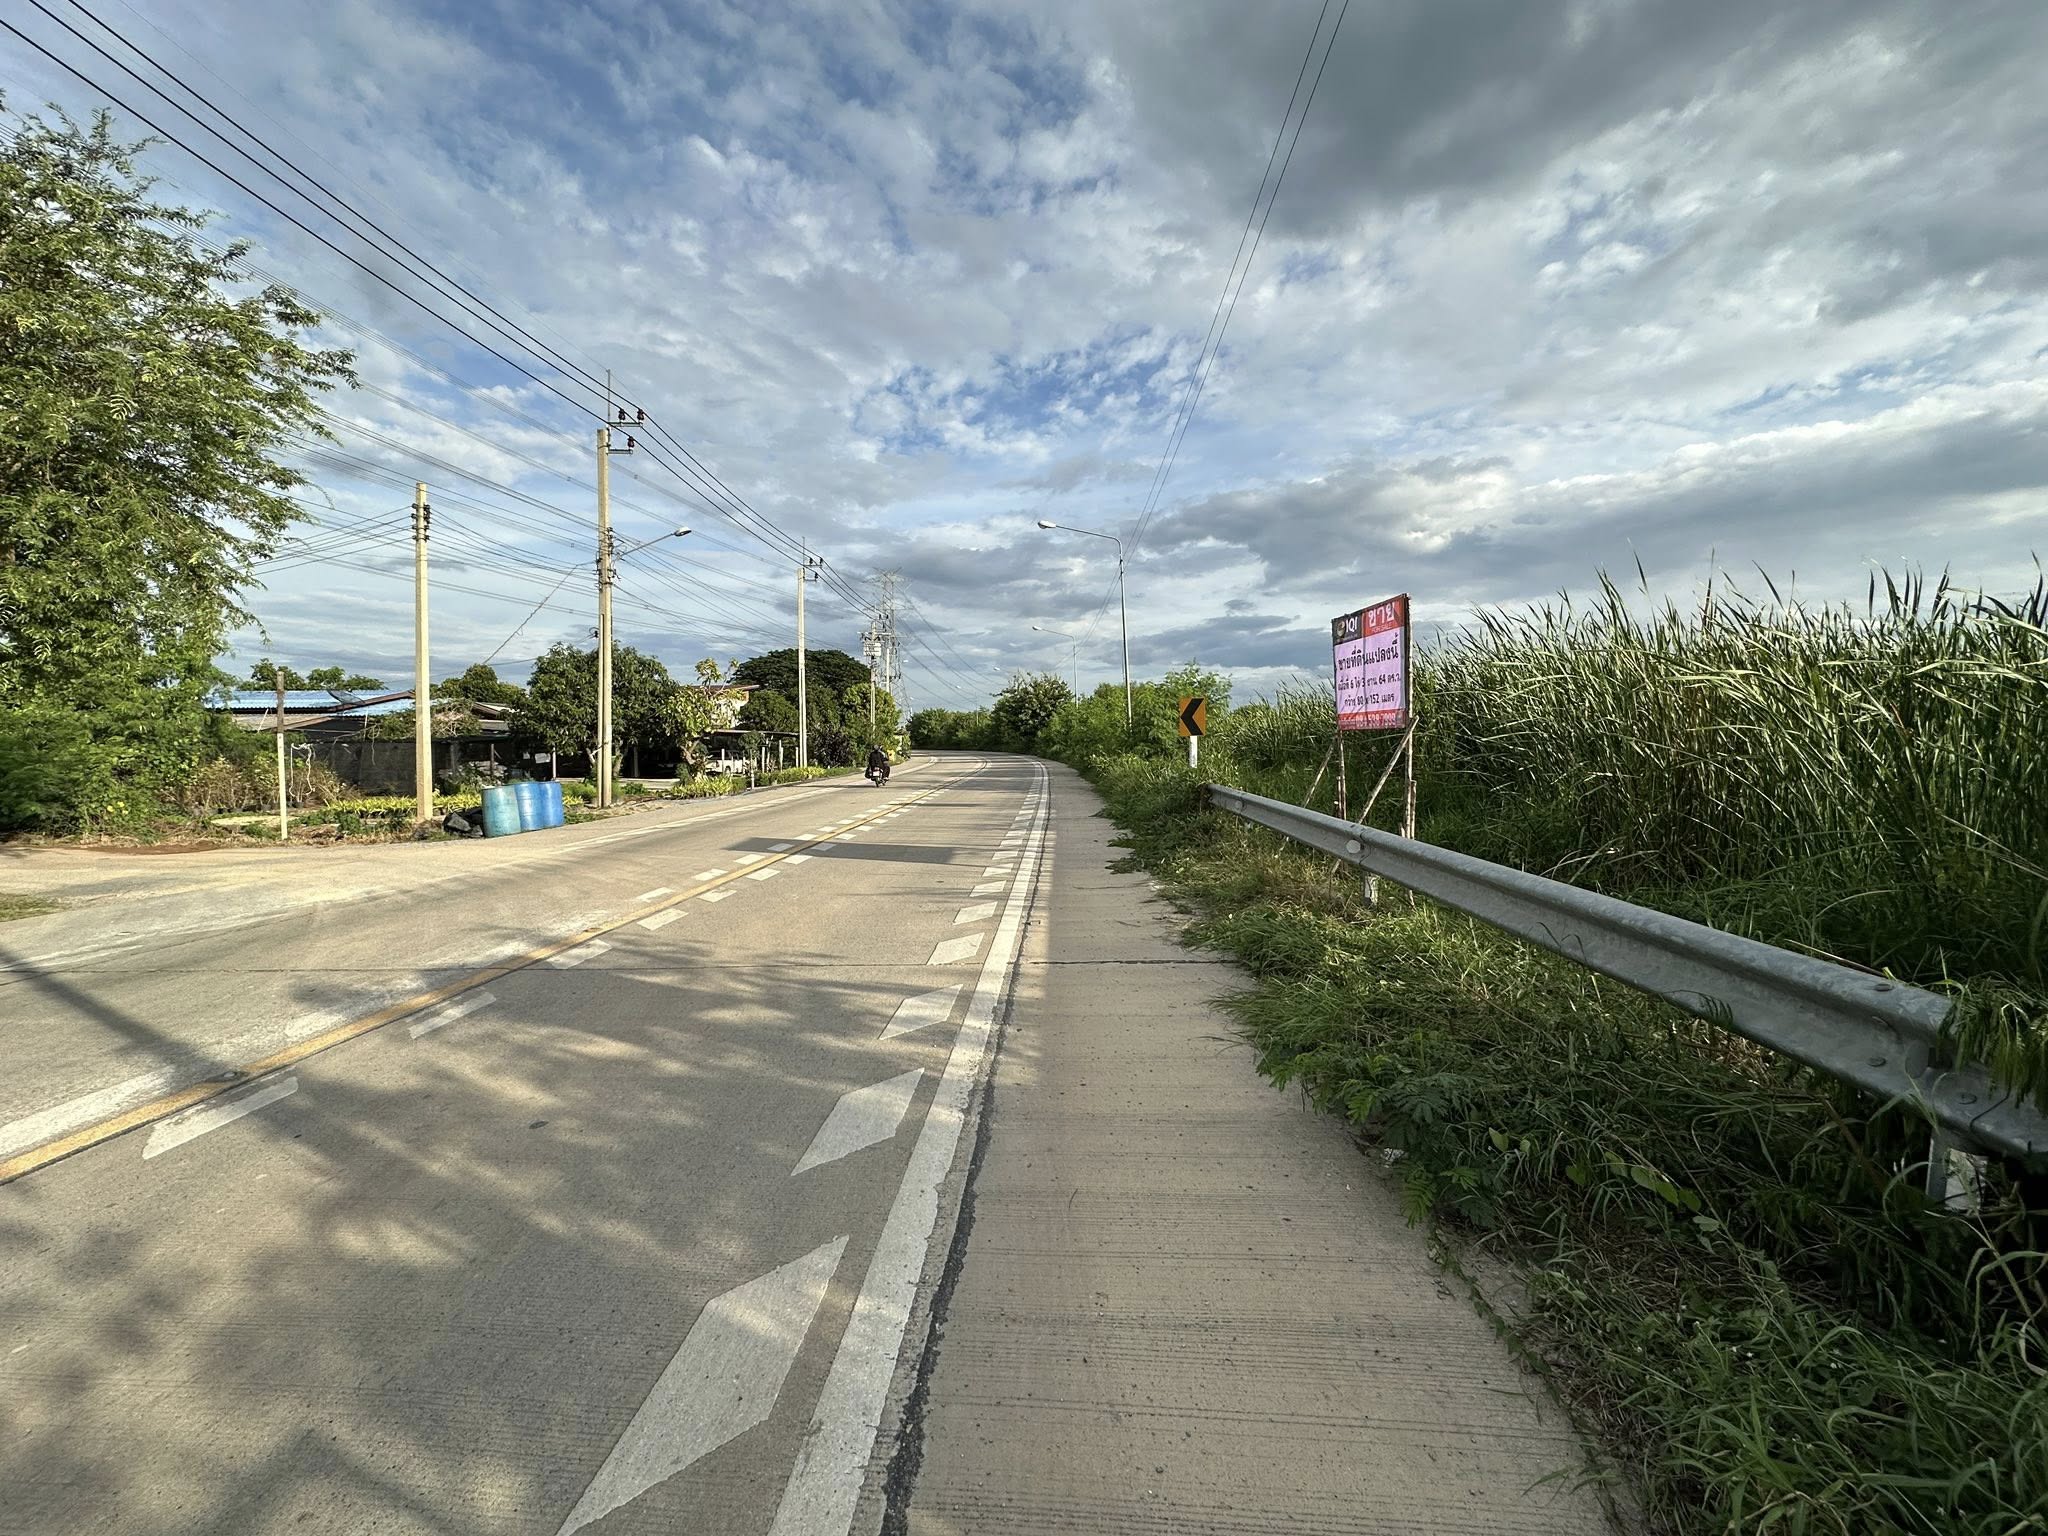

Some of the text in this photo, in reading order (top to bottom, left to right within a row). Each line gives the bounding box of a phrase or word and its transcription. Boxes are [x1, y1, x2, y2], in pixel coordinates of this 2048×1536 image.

[1346, 616, 1358, 632] IQI
[1368, 602, 1395, 627] ขาย
[1338, 633, 1399, 670] ขายที่ดินแปลงนี้
[1379, 674, 1386, 685] 64
